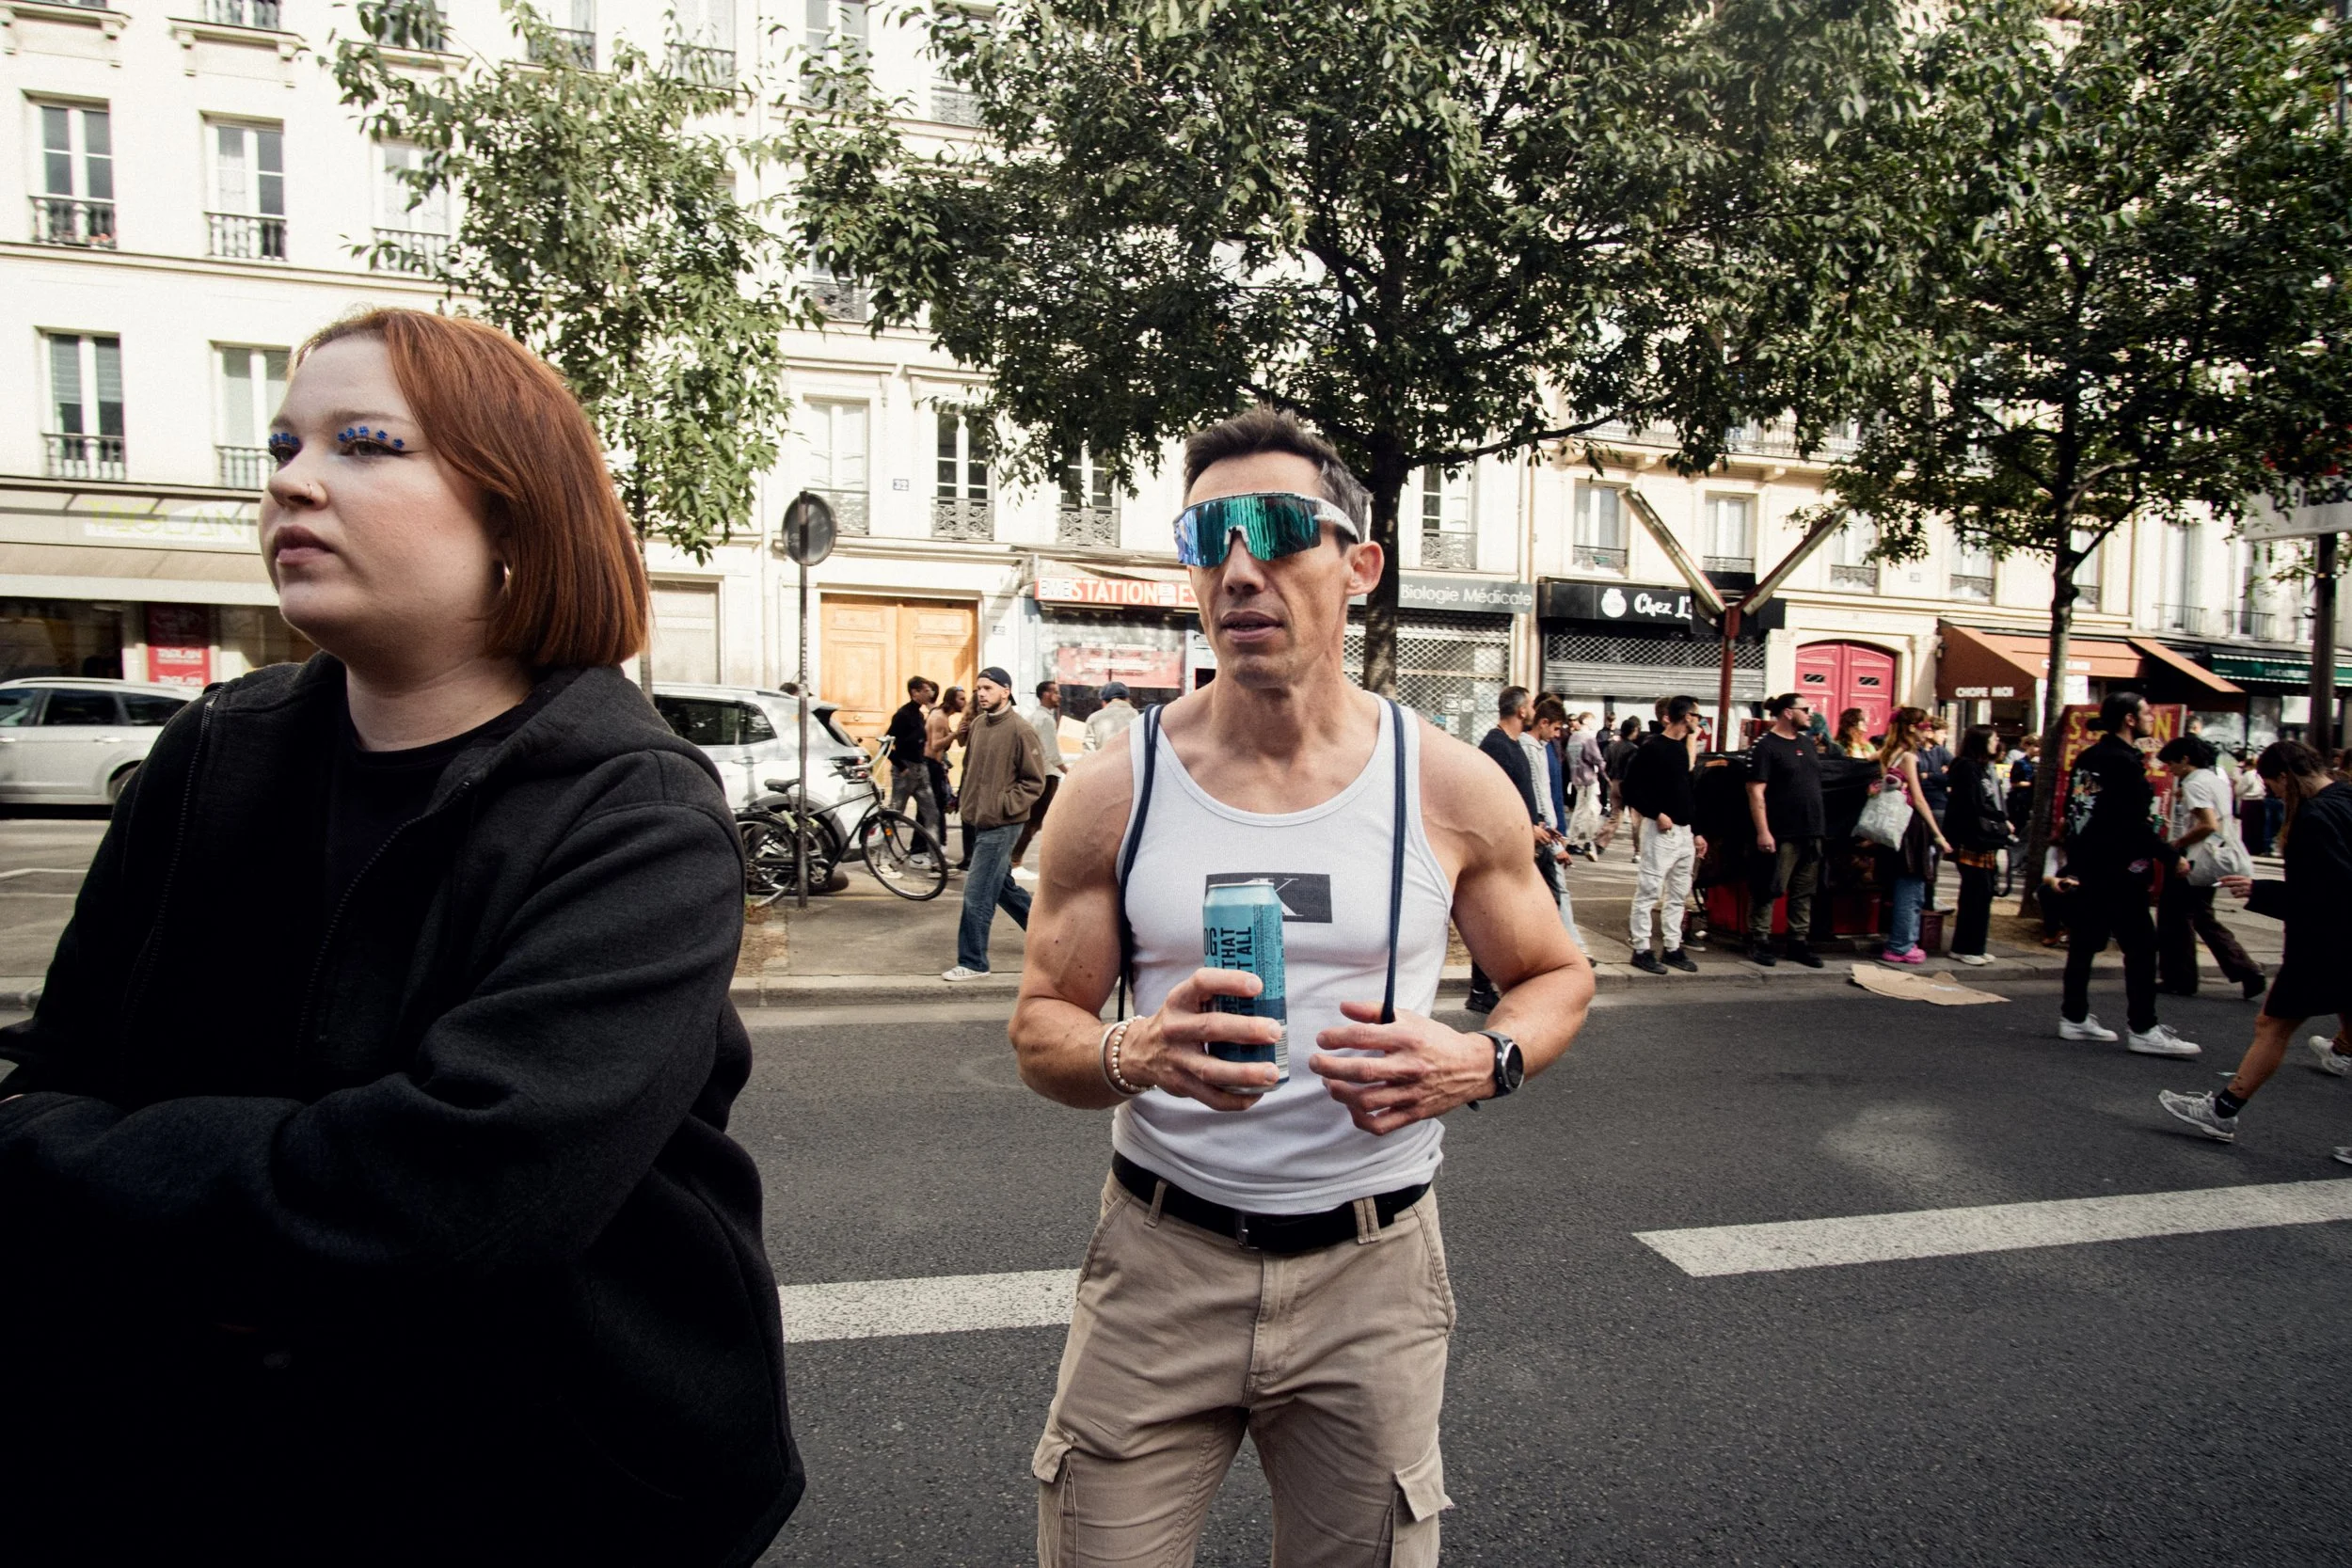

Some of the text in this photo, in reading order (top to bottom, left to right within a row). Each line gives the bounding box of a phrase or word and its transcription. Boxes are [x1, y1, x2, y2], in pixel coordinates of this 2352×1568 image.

[1071, 579, 1158, 605] STATION
[1401, 583, 1533, 607] Biologie Médicale
[1634, 593, 1673, 617] Chez
[1991, 687, 2014, 698] MOI
[1221, 927, 1235, 970] THAT
[1236, 927, 1252, 955] ALL
